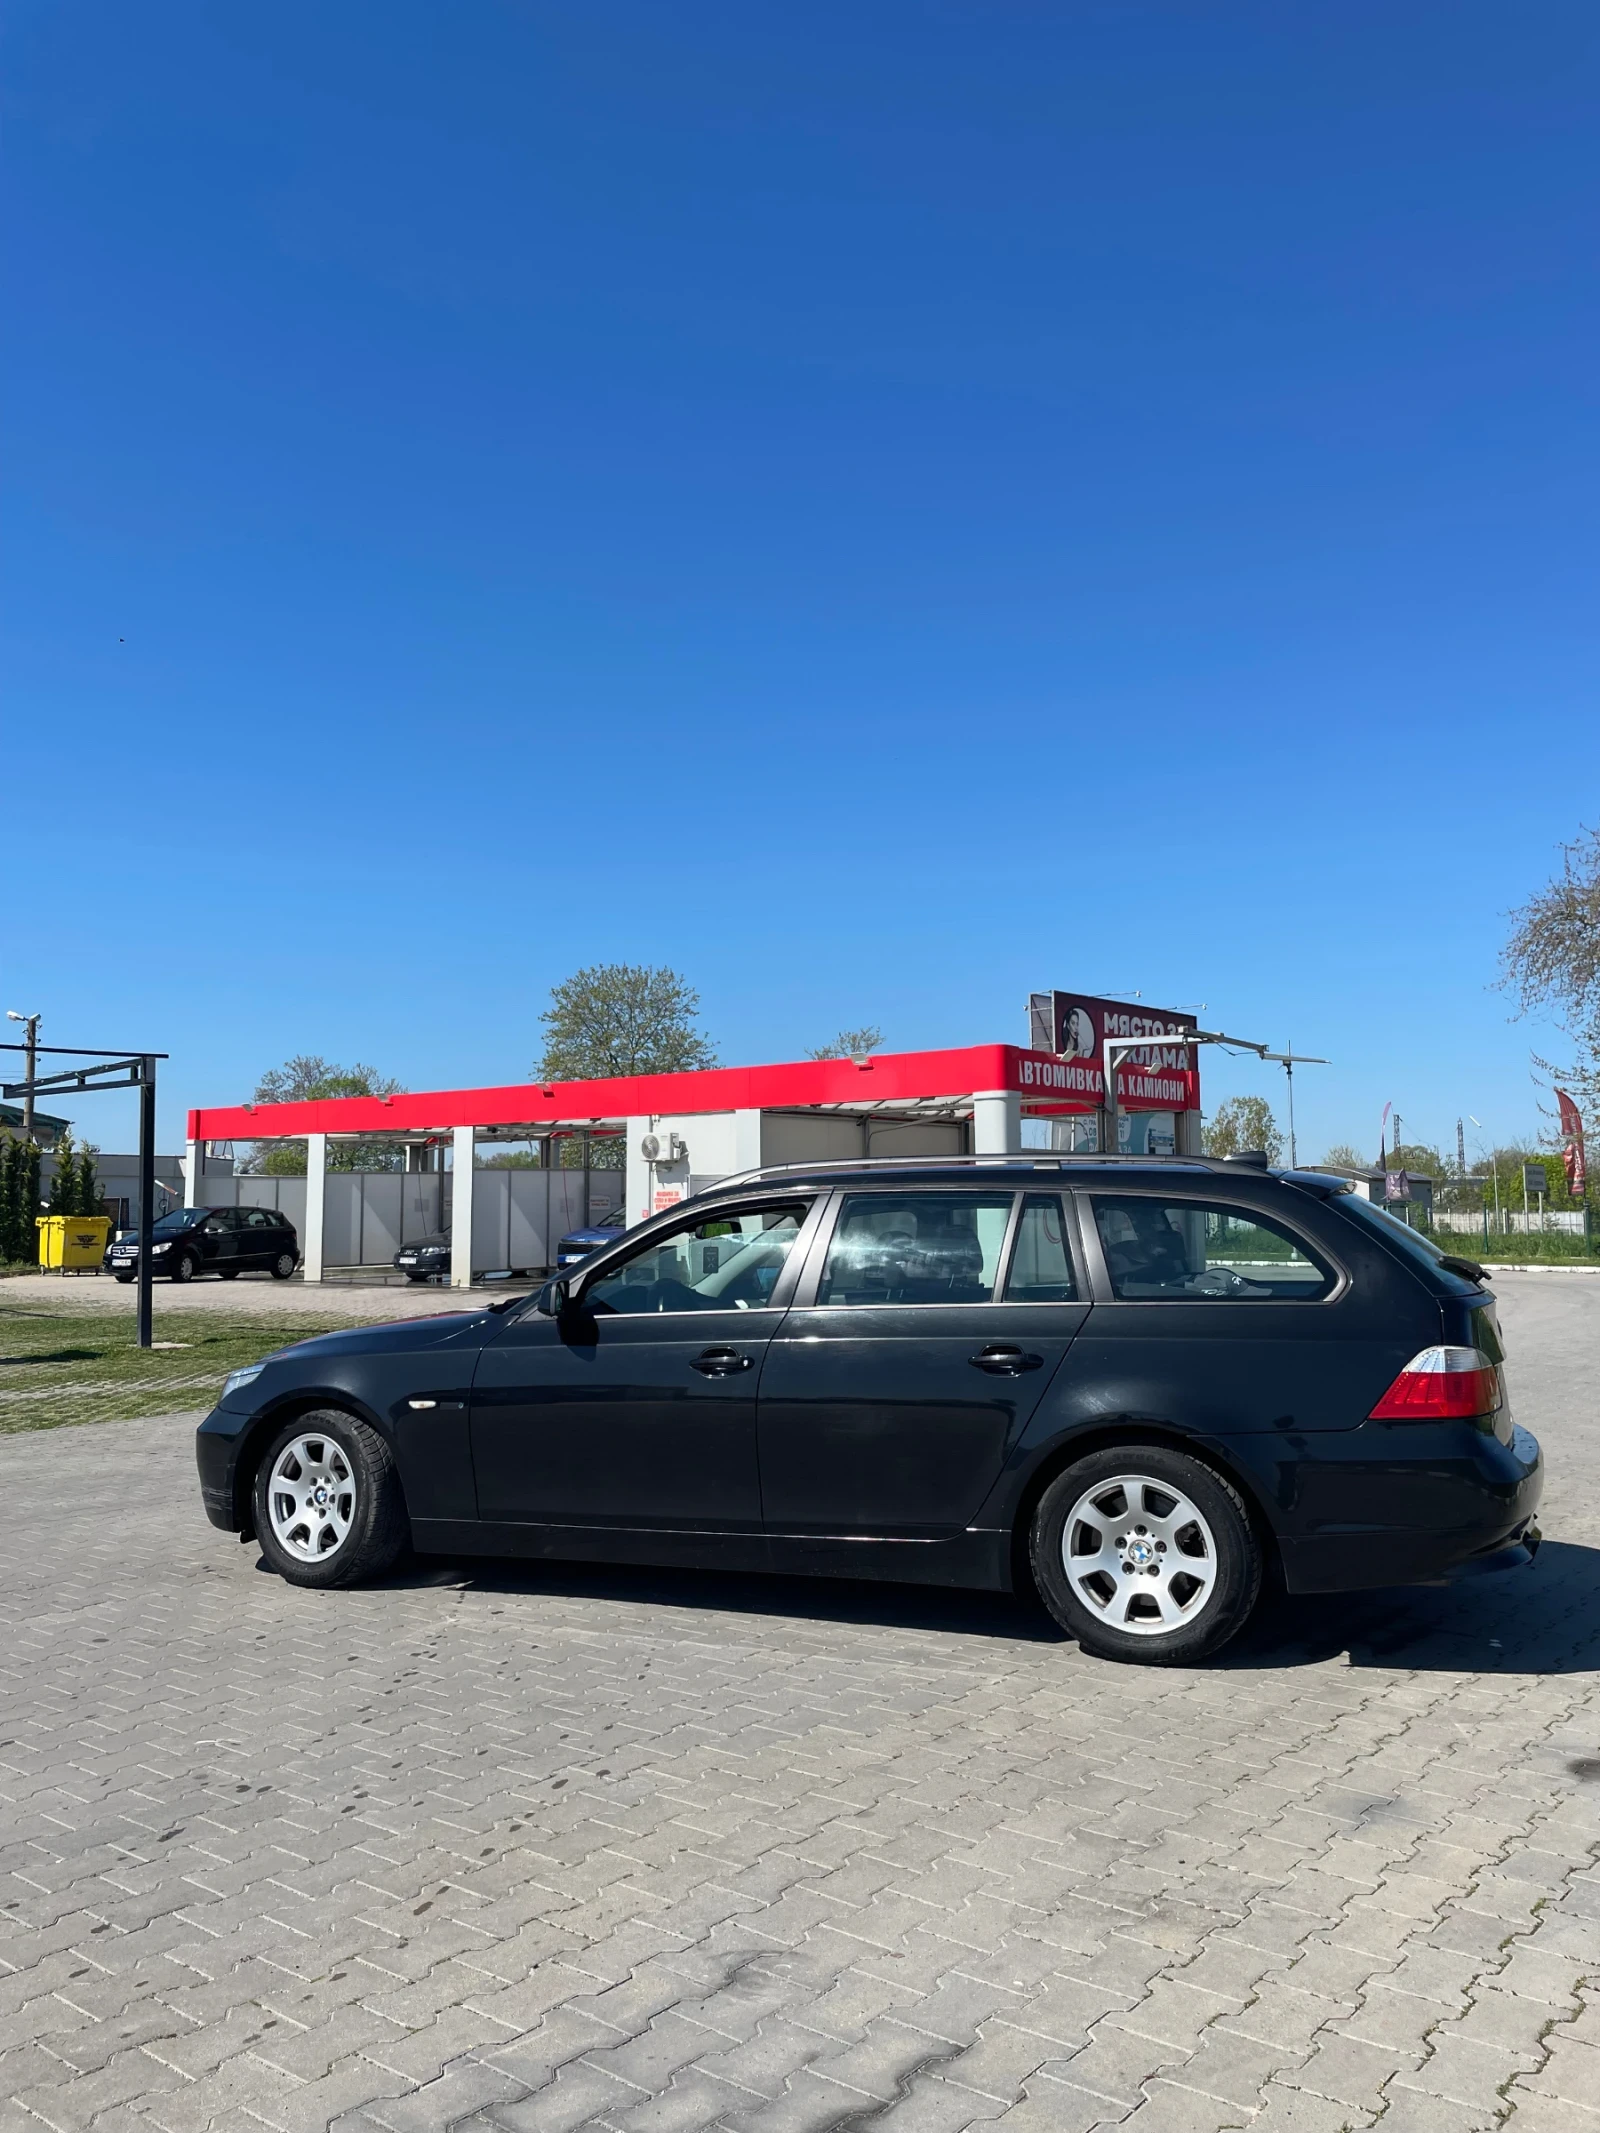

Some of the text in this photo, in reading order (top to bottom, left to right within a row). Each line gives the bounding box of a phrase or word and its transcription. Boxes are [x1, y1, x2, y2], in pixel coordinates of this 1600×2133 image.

[1104, 1012, 1164, 1037] МЯСТО
[1116, 1046, 1188, 1070] КЛАМА
[1117, 1074, 1125, 1096] А
[1128, 1075, 1184, 1102] КАМИОНИ
